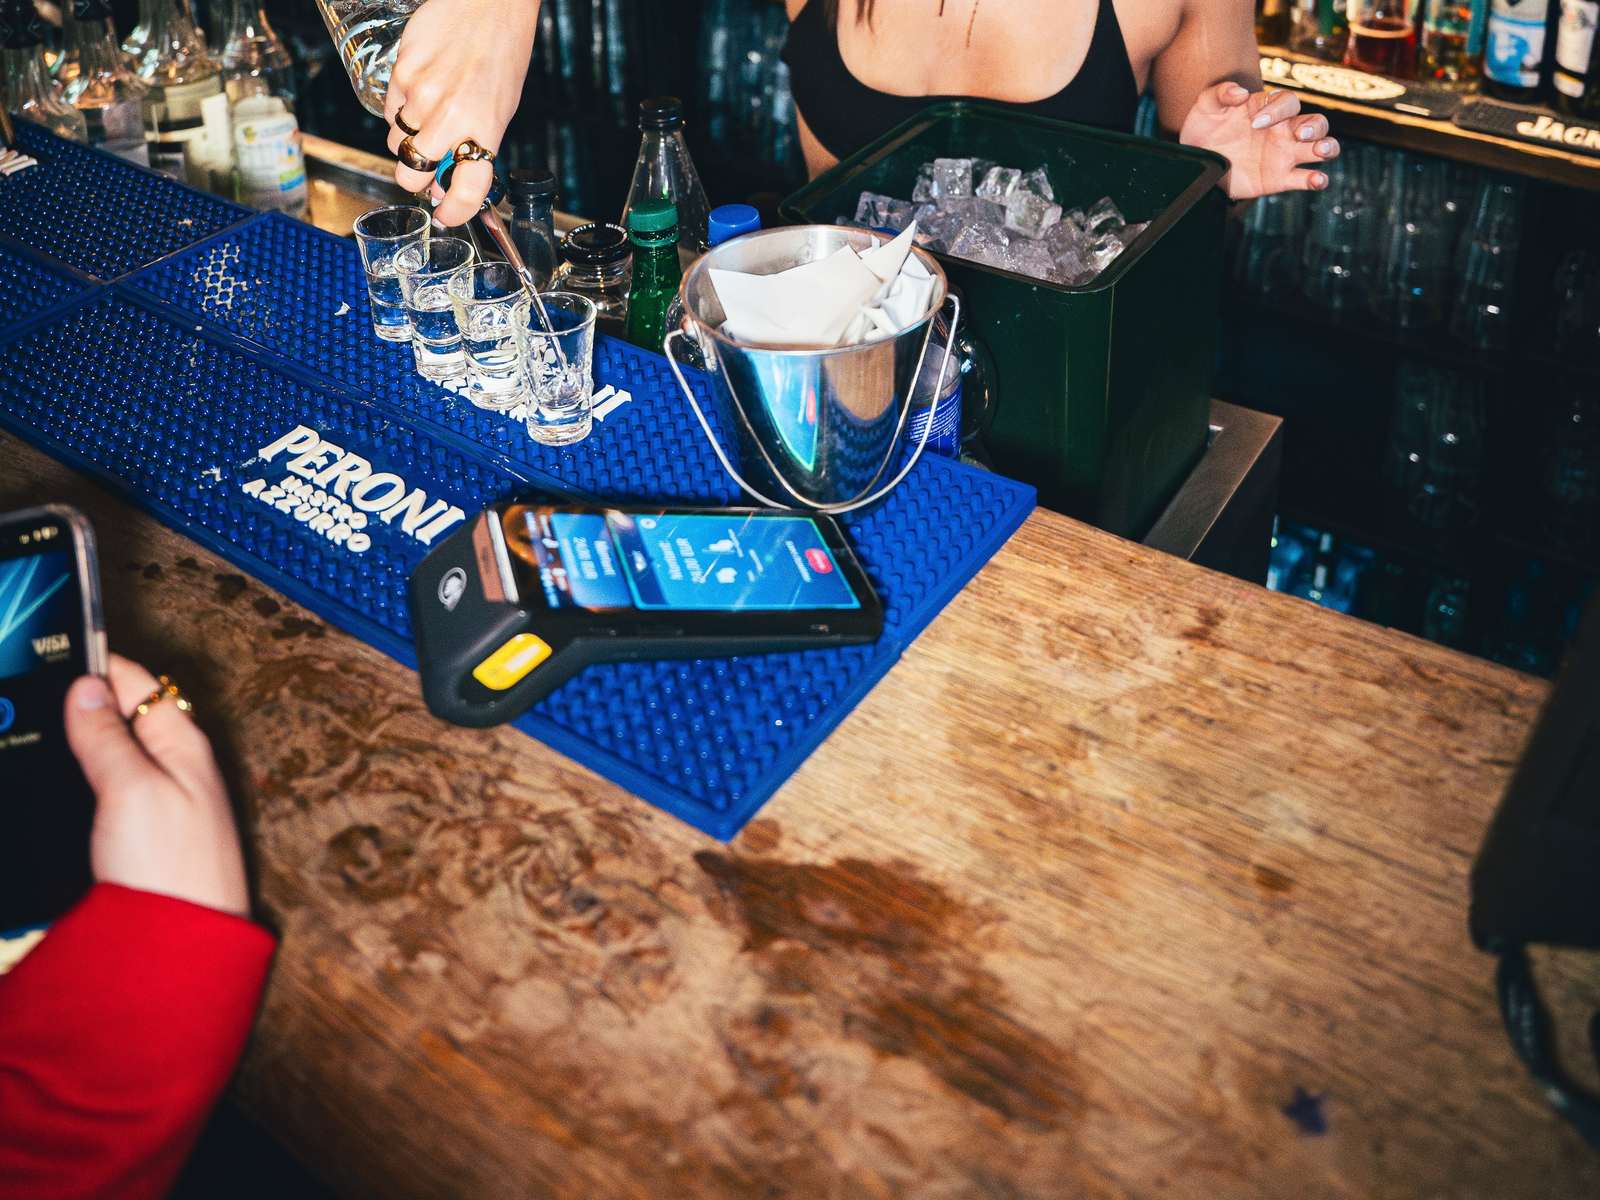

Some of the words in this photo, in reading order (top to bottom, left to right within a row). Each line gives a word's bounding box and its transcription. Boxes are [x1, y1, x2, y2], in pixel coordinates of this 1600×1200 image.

[241, 478, 372, 553] AZZURRO
[258, 424, 466, 546] PERONI
[280, 474, 368, 530] NASTRO
[32, 633, 71, 656] VISA
